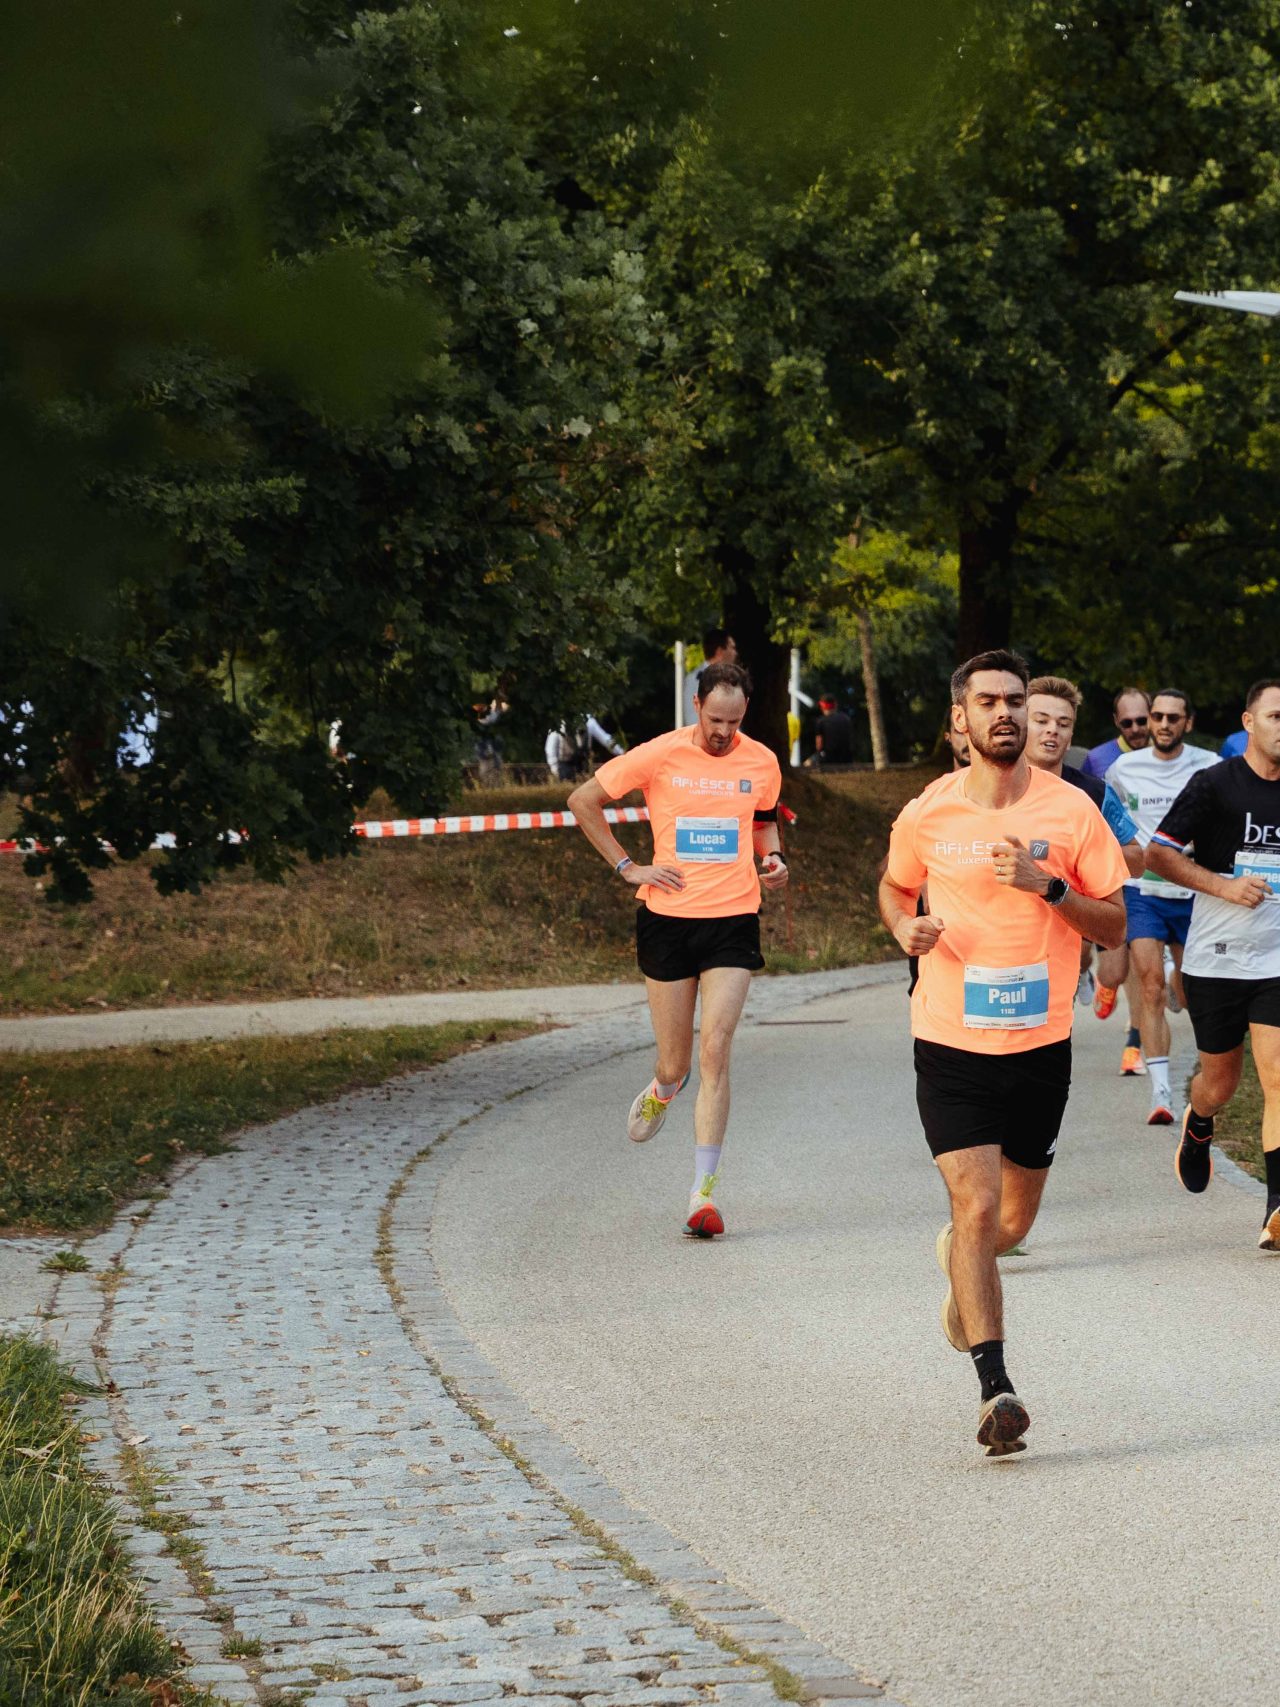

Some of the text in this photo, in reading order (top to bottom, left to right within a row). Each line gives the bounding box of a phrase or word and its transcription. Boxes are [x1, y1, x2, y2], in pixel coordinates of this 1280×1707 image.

[1142, 797, 1163, 805] BNP
[689, 831, 726, 845] Lucas
[988, 986, 1026, 1004] Paul
